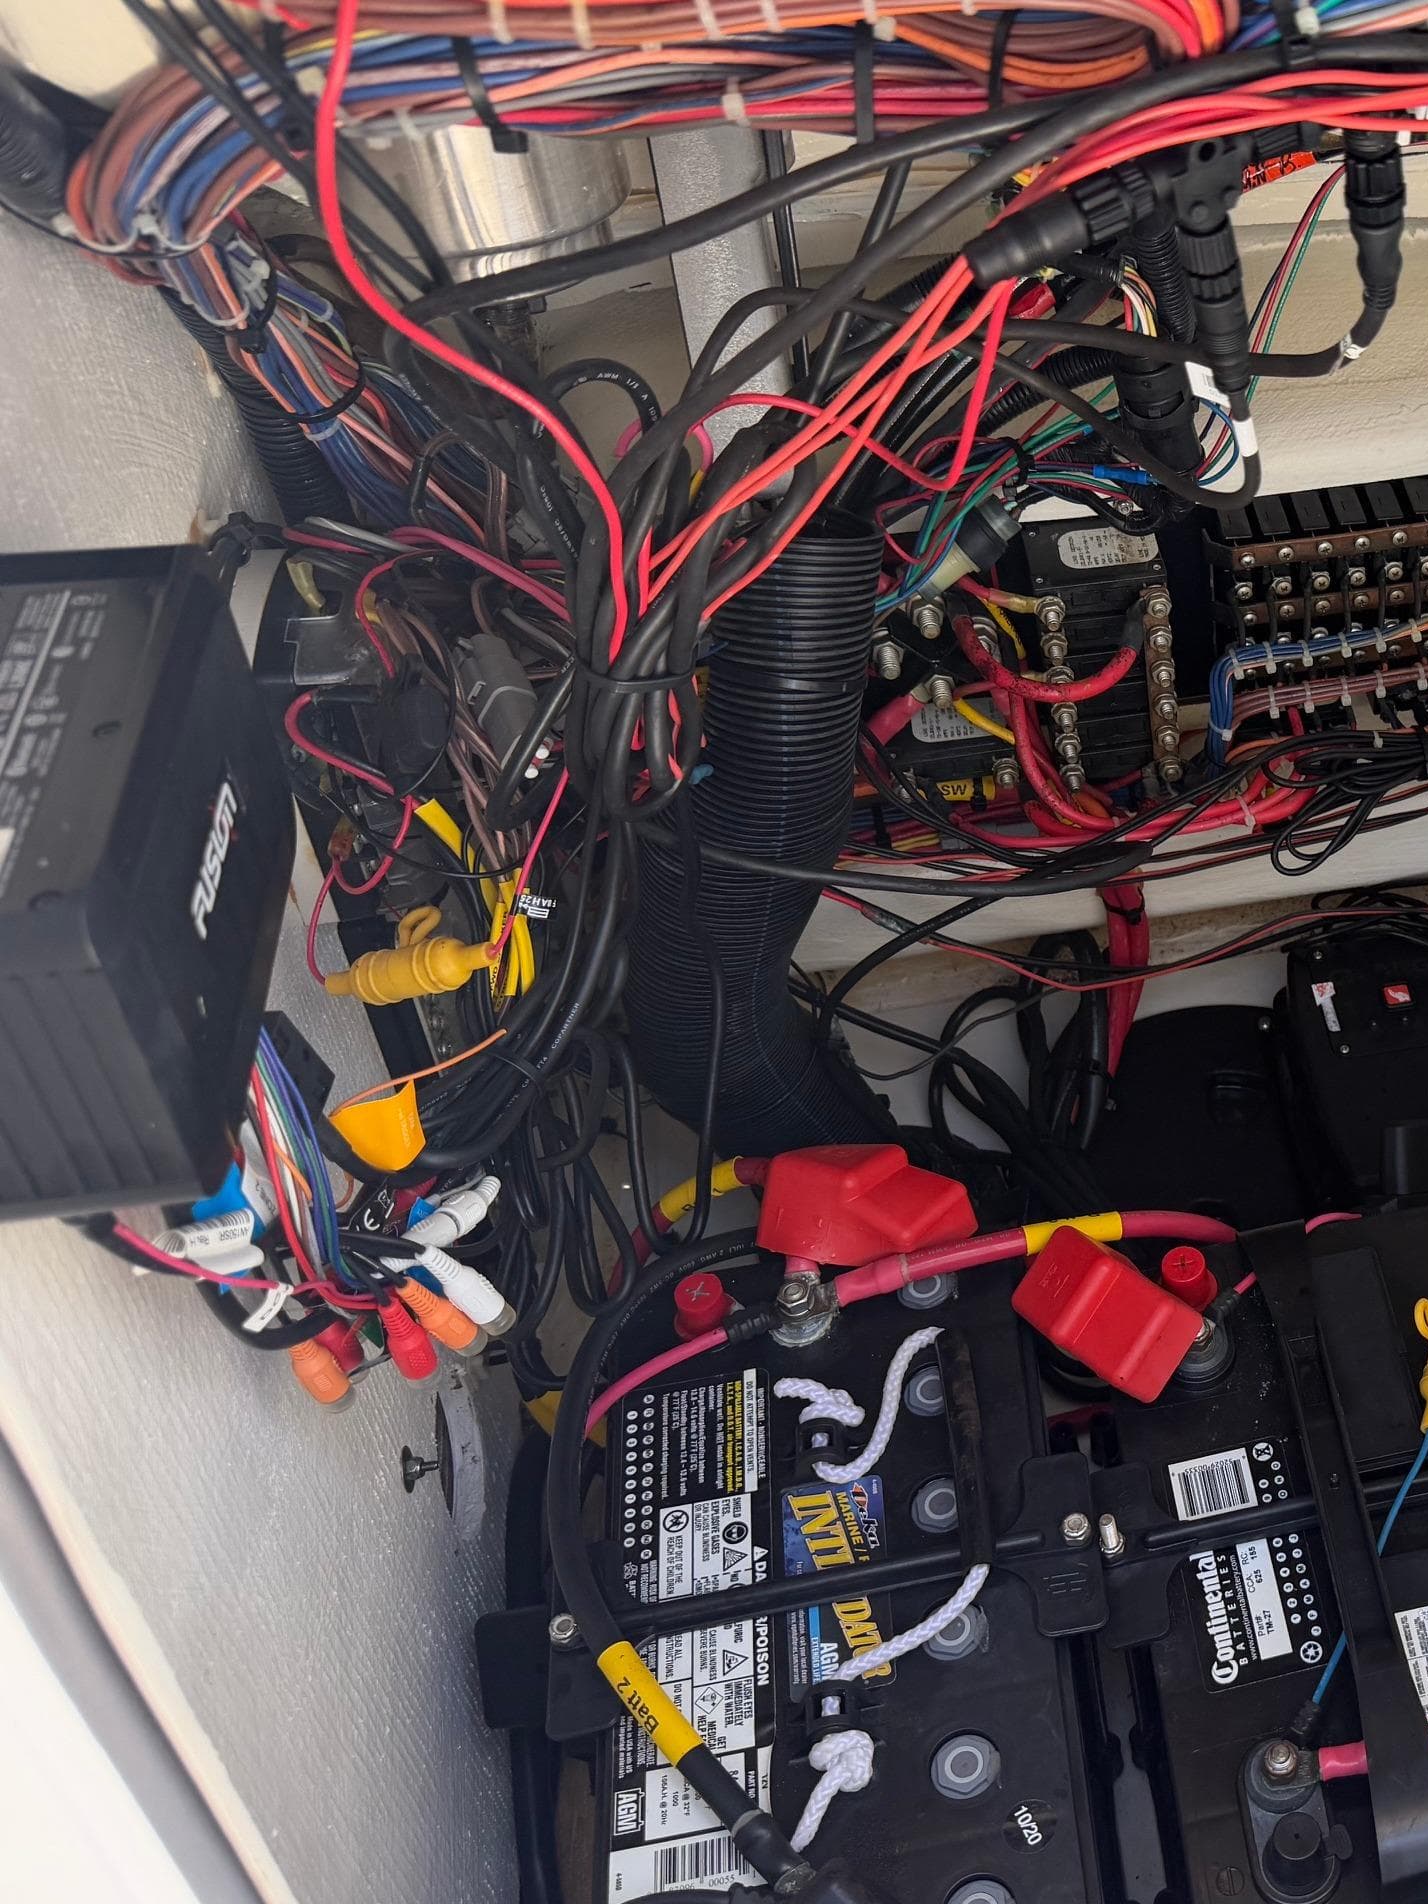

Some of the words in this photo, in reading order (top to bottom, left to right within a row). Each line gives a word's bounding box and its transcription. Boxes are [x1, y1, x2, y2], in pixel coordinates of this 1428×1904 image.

[746, 1381, 754, 1389] DO
[746, 1390, 754, 1401] NOT
[746, 1402, 754, 1427] ATTEMPT
[746, 1437, 754, 1452] OPEN
[694, 1504, 701, 1512] OR
[702, 1503, 710, 1514] CAN
[721, 1499, 730, 1517] EYES.
[733, 1497, 742, 1518] SHIELD
[702, 1514, 710, 1532] CAUSE
[711, 1500, 720, 1534] EXPLOSIVE
[836, 1491, 864, 1545] MARINE
[666, 1537, 675, 1556] REACH
[674, 1535, 683, 1549] KEEP
[702, 1533, 710, 1562] BLINDNESS
[711, 1535, 720, 1555] GASES
[666, 1556, 675, 1565] OF
[674, 1550, 683, 1563] OUT
[1248, 1546, 1258, 1560] 155
[674, 1572, 683, 1584] THE
[1253, 1569, 1263, 1584] 625
[1216, 1554, 1249, 1666] BATTERIES
[1229, 1554, 1258, 1661] www.continentalbattery.com
[1188, 1550, 1239, 1684] Continental
[1262, 1609, 1275, 1635] TM-27
[708, 1630, 717, 1648] CAUSE
[674, 1649, 683, 1660] ALL
[699, 1650, 708, 1672] BURNS.
[811, 1637, 820, 1668] EXTENDED
[819, 1642, 839, 1680] AGM
[708, 1649, 717, 1680] BLINDNESS
[617, 1676, 631, 1694] 2
[673, 1683, 682, 1692] DO
[724, 1683, 734, 1700] WITH
[743, 1680, 753, 1700] FLUSH
[673, 1694, 682, 1708] NOT
[734, 1681, 744, 1726] IMMEDIATELY
[628, 1690, 659, 1735] Batt
[724, 1702, 734, 1728] WATER.
[743, 1702, 753, 1719] EYES
[697, 1715, 707, 1732] HELP
[717, 1736, 726, 1749] GET
[747, 1771, 755, 1787] PART
[616, 1793, 637, 1832] AGM
[1013, 1805, 1043, 1846] 10/20
